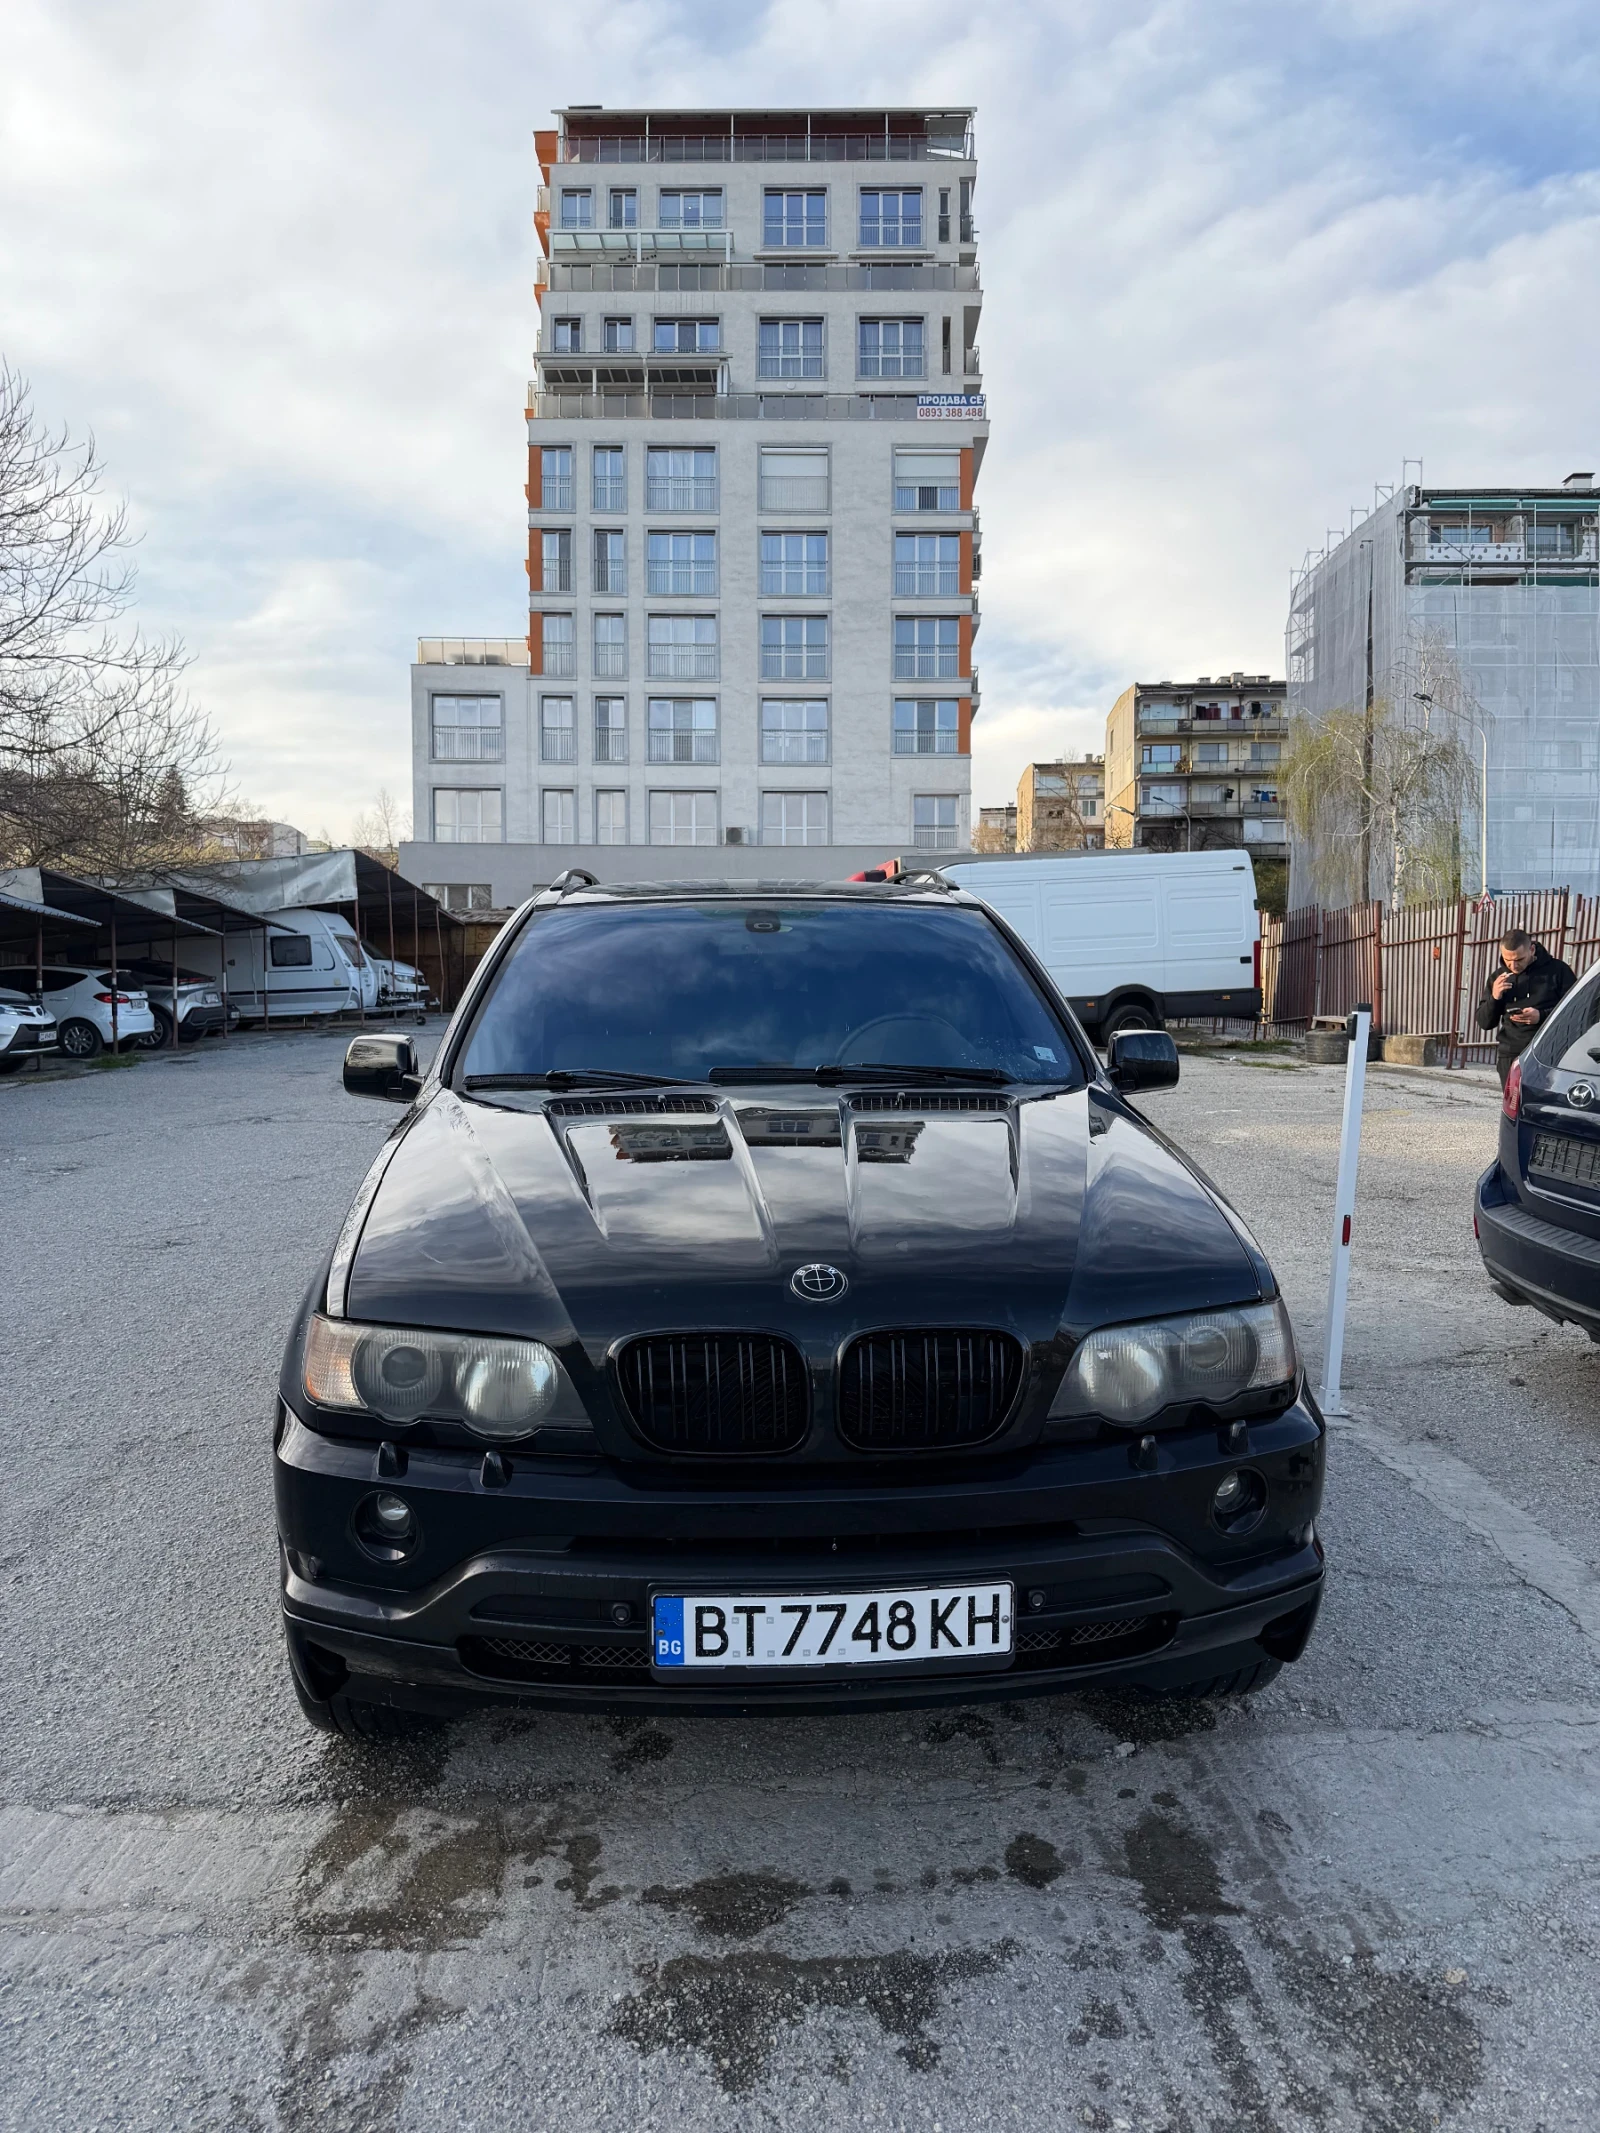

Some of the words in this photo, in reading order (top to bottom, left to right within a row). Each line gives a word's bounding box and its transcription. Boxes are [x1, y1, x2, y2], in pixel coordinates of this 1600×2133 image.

[918, 395, 967, 406] ПРОДАВА
[919, 407, 942, 417] 0893
[945, 407, 963, 417] 388
[965, 407, 983, 417] 488
[796, 1264, 838, 1276] BMW
[780, 1600, 917, 1657] 7748
[658, 1639, 682, 1655] BG
